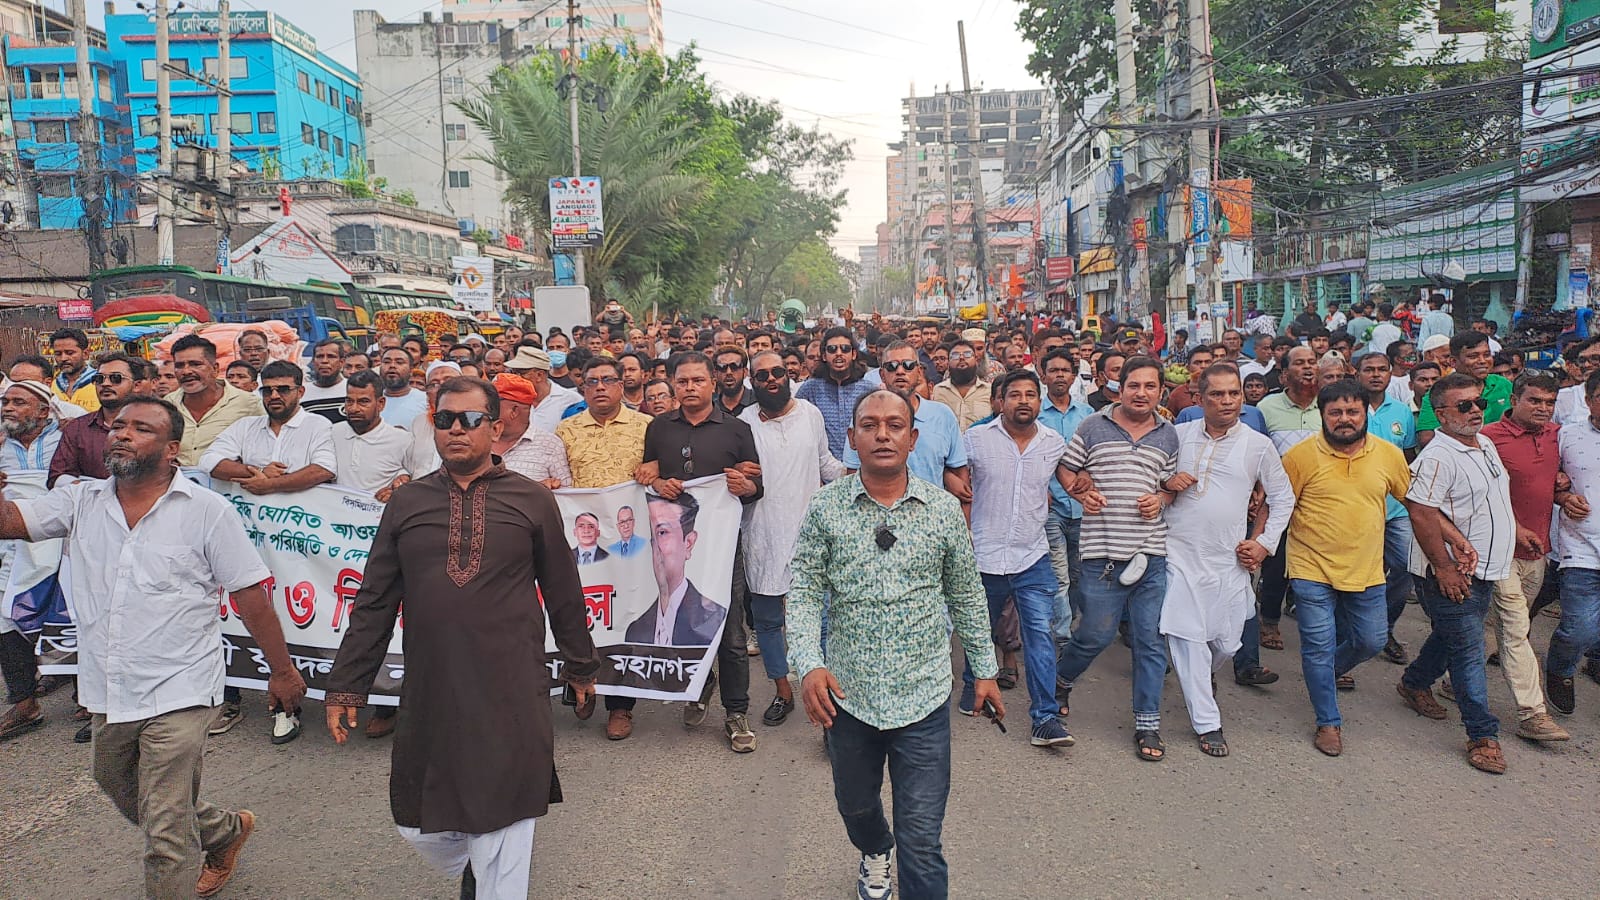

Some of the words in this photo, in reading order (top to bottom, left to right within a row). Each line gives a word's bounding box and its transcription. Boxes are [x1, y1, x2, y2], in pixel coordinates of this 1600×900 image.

[258, 505, 323, 529] ঘোষিত
[269, 529, 325, 559] পরিস্থিতি
[328, 545, 341, 558] ও
[284, 580, 316, 629] ও
[607, 654, 703, 682] মহানগর
